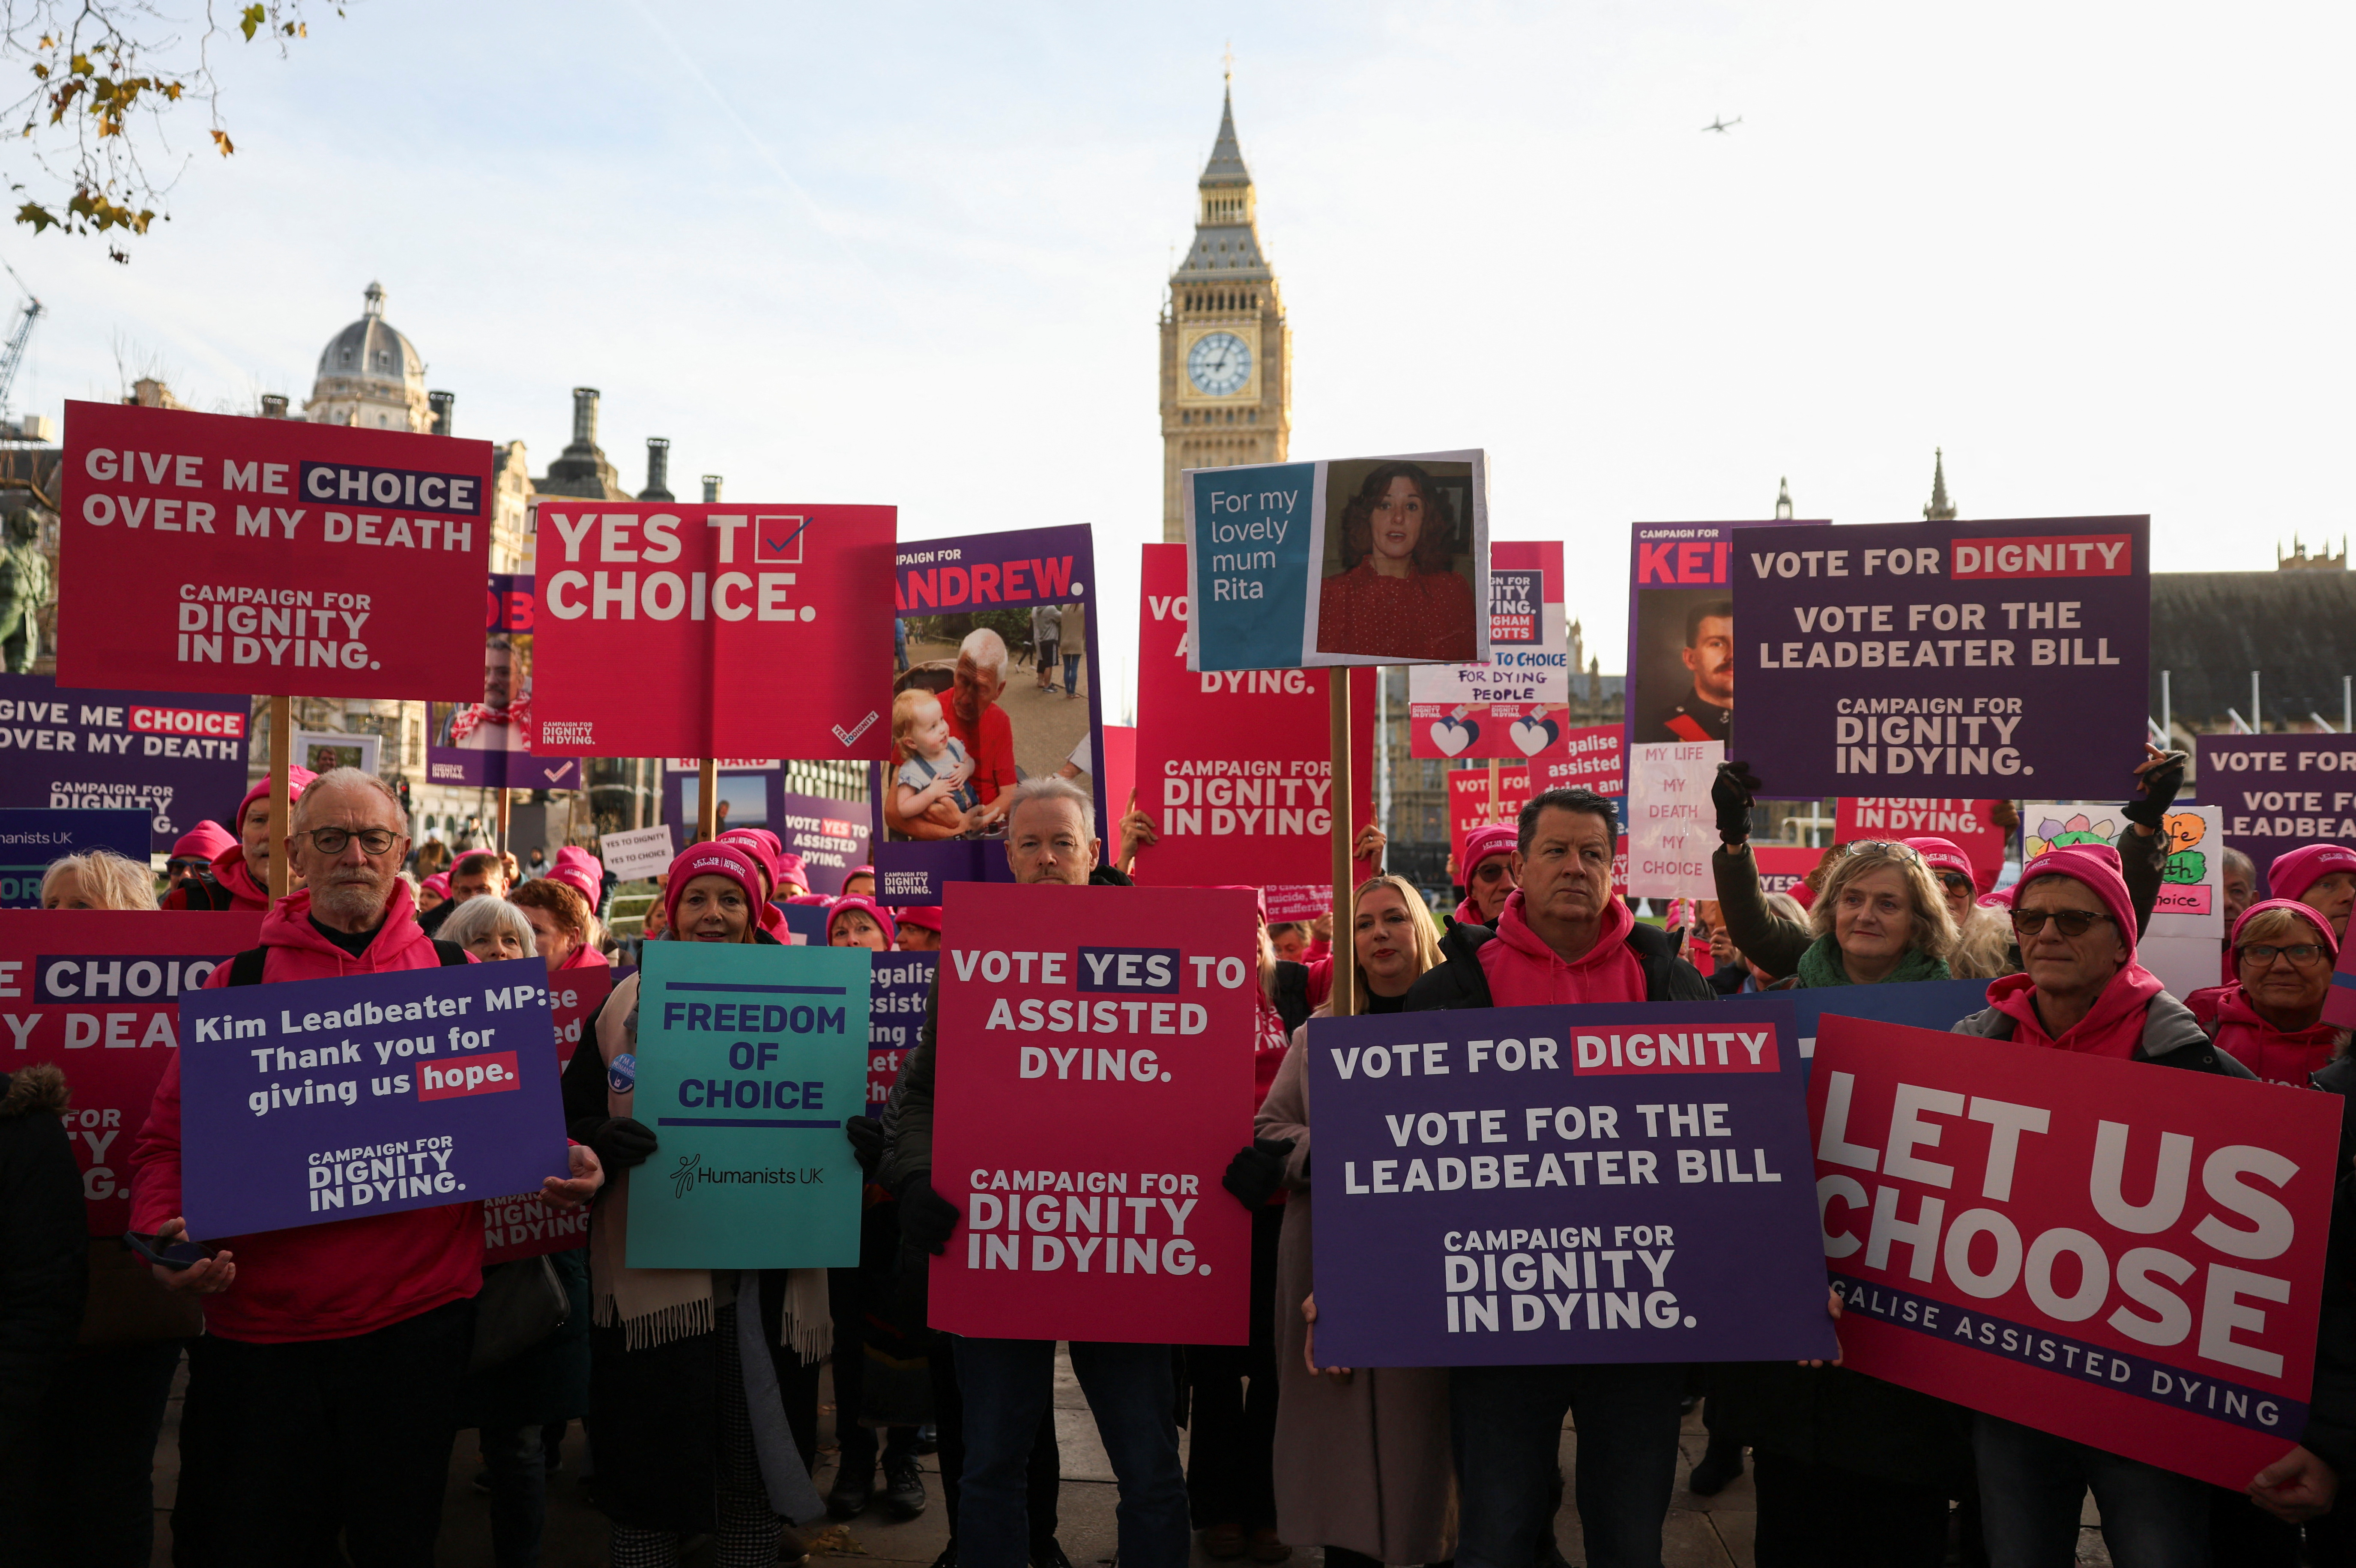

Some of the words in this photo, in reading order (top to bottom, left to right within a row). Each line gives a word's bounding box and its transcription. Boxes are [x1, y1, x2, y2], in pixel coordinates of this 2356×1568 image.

[85, 447, 203, 487] GIVE
[223, 459, 289, 495] ME
[306, 466, 474, 510] CHOICE
[1211, 490, 1252, 514] For
[1260, 490, 1298, 514] my
[82, 493, 216, 535] OVER
[235, 506, 307, 540] MY
[324, 511, 472, 552] DEATH
[1212, 517, 1289, 544] lovely
[1640, 530, 1696, 539] CAMPAIGN
[1698, 529, 1719, 538] FOR
[550, 513, 682, 563] YES
[937, 548, 961, 562] FOR
[1213, 550, 1276, 573] mum
[1751, 550, 1849, 579] VOTE
[1865, 547, 1940, 576] FOR
[1956, 541, 2125, 573] DIGNITY
[1214, 578, 1263, 601] Rita
[1508, 577, 1530, 585] FOR
[179, 583, 312, 606] CAMPAIGN
[323, 591, 371, 610] FOR
[546, 570, 816, 622] CHOICE.
[179, 603, 369, 640] DIGNITY
[1794, 605, 1893, 633] VOTE
[1909, 603, 1986, 631] FOR
[2001, 601, 2081, 629] THE
[177, 633, 222, 664] IN
[233, 637, 381, 671] DYING.
[1495, 652, 1513, 666] TO
[1517, 652, 1567, 666] CHOICE
[1760, 639, 2015, 669] LEADBEATER
[2031, 638, 2120, 666] BILL
[1201, 669, 1315, 694] DYING.
[1458, 670, 1486, 683] FOR
[1493, 672, 1548, 684] DYING
[1474, 688, 1535, 701] PEOPLE
[1837, 698, 1963, 714] CAMPAIGN
[1974, 698, 2023, 714] FOR
[0, 699, 69, 723] GIVE
[80, 705, 123, 727] ME
[133, 709, 240, 735] CHOICE
[0, 728, 75, 752] OVER
[88, 733, 133, 755] MY
[144, 736, 238, 761] DEATH
[542, 735, 554, 744] IN
[556, 735, 595, 745] DYING.
[543, 727, 592, 736] DIGNITY
[835, 727, 847, 739] YES
[1837, 716, 2022, 746] DIGNITY
[1549, 754, 1621, 777] assisted
[1645, 747, 1667, 761] MY
[1675, 747, 1704, 760] LIFE
[1837, 746, 1878, 774] IN
[1887, 747, 2034, 776] DYING.
[2210, 752, 2287, 771] VOTE
[1165, 760, 1282, 776] CAMPAIGN
[1291, 761, 1331, 776] FOR
[51, 781, 129, 794] CAMPAIGN
[143, 785, 173, 797] FOR
[1164, 778, 1331, 806] DIGNITY
[1664, 780, 1686, 792] MY
[50, 792, 172, 815] DIGNITY
[1650, 804, 1698, 818] DEATH
[2243, 791, 2322, 811] VOTE
[786, 815, 820, 831] VOTE
[823, 820, 850, 836] YES
[852, 824, 868, 838] TO
[1164, 808, 1202, 835] IN
[1856, 808, 1884, 828] IN
[1890, 810, 1985, 833] DYING.
[53, 832, 72, 844] UK
[634, 833, 664, 844] DIGNITY
[793, 833, 857, 854] ASSISTED
[1662, 836, 1685, 849] MY
[638, 849, 665, 860] CHOICE
[802, 851, 846, 868] DYING.
[885, 877, 928, 886] DIGNITY
[1643, 861, 1703, 876] CHOICE
[885, 886, 896, 894] IN
[897, 886, 931, 894] DYING.
[1267, 892, 1309, 903] suicide,
[951, 950, 1067, 985] VOTE
[1083, 953, 1172, 987] YES
[1189, 955, 1246, 989] TO
[195, 1015, 266, 1043] Kim
[281, 996, 472, 1034] Leadbeater
[485, 985, 547, 1013] MP:
[663, 1003, 845, 1035] FREEDOM
[985, 999, 1208, 1035] ASSISTED
[251, 1040, 362, 1074] Thank
[374, 1034, 436, 1066] you
[448, 1028, 496, 1052] for
[619, 1055, 630, 1066] I'M
[729, 1042, 778, 1070] OF
[1331, 1042, 1450, 1080] VOTE
[1468, 1037, 1560, 1073] FOR
[1578, 1032, 1769, 1069] DIGNITY
[1020, 1047, 1172, 1083] DYING.
[248, 1076, 358, 1116] giving
[371, 1073, 411, 1096] us
[423, 1060, 514, 1093] hope.
[678, 1079, 824, 1110] CHOICE
[1385, 1109, 1508, 1147] VOTE
[1526, 1105, 1620, 1142] FOR
[1636, 1103, 1732, 1137] THE
[308, 1142, 409, 1165] CAMPAIGN
[415, 1135, 453, 1151] FOR
[309, 1149, 453, 1189] DIGNITY
[699, 1167, 796, 1184] Humanists
[800, 1168, 824, 1183] UK
[1345, 1151, 1659, 1195] LEADBEATER
[1677, 1149, 1782, 1184] BILL
[1817, 1070, 2051, 1203] LET
[2089, 1119, 2301, 1260] US
[310, 1187, 344, 1212] IN
[351, 1172, 466, 1206] DYING.
[970, 1169, 1127, 1194] CAMPAIGN
[1141, 1174, 1199, 1195] FOR
[968, 1193, 1199, 1235] DIGNITY
[1444, 1227, 1601, 1252] CAMPAIGN
[1615, 1225, 1674, 1247] FOR
[968, 1233, 1019, 1270] IN
[1032, 1236, 1211, 1276] DYING.
[1444, 1249, 1675, 1293] DIGNITY
[1819, 1174, 2291, 1379] CHOOSE
[1447, 1295, 1500, 1333] IN
[1512, 1291, 1697, 1332] DYING.
[1955, 1316, 2131, 1383] ASSISTED
[2151, 1371, 2280, 1426] DYING
